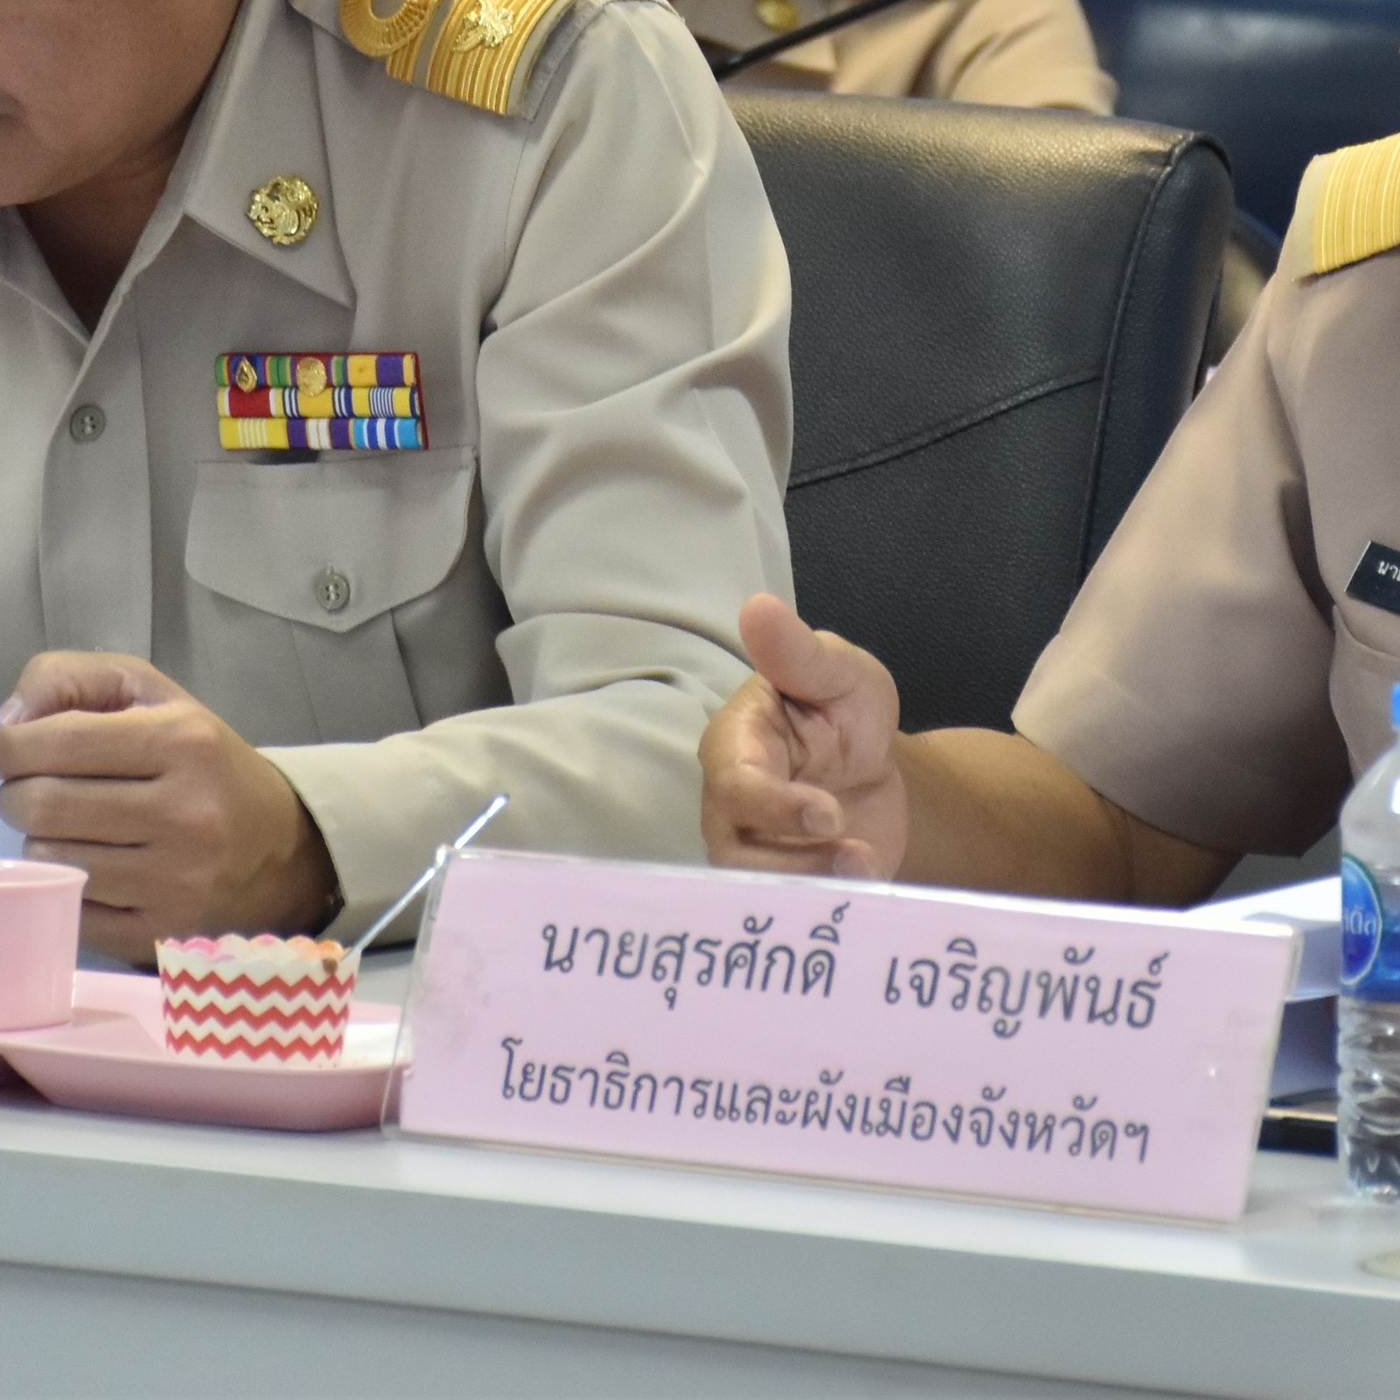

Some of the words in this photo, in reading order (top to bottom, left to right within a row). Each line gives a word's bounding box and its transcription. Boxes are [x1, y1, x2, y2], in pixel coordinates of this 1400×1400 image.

[541, 901, 851, 1011] นายสุรศักดิ์
[882, 932, 1170, 1040] เจริญพันธ์
[500, 1036, 1152, 1165] โยธาธิการและผังเมืองจังหวัดฯ
